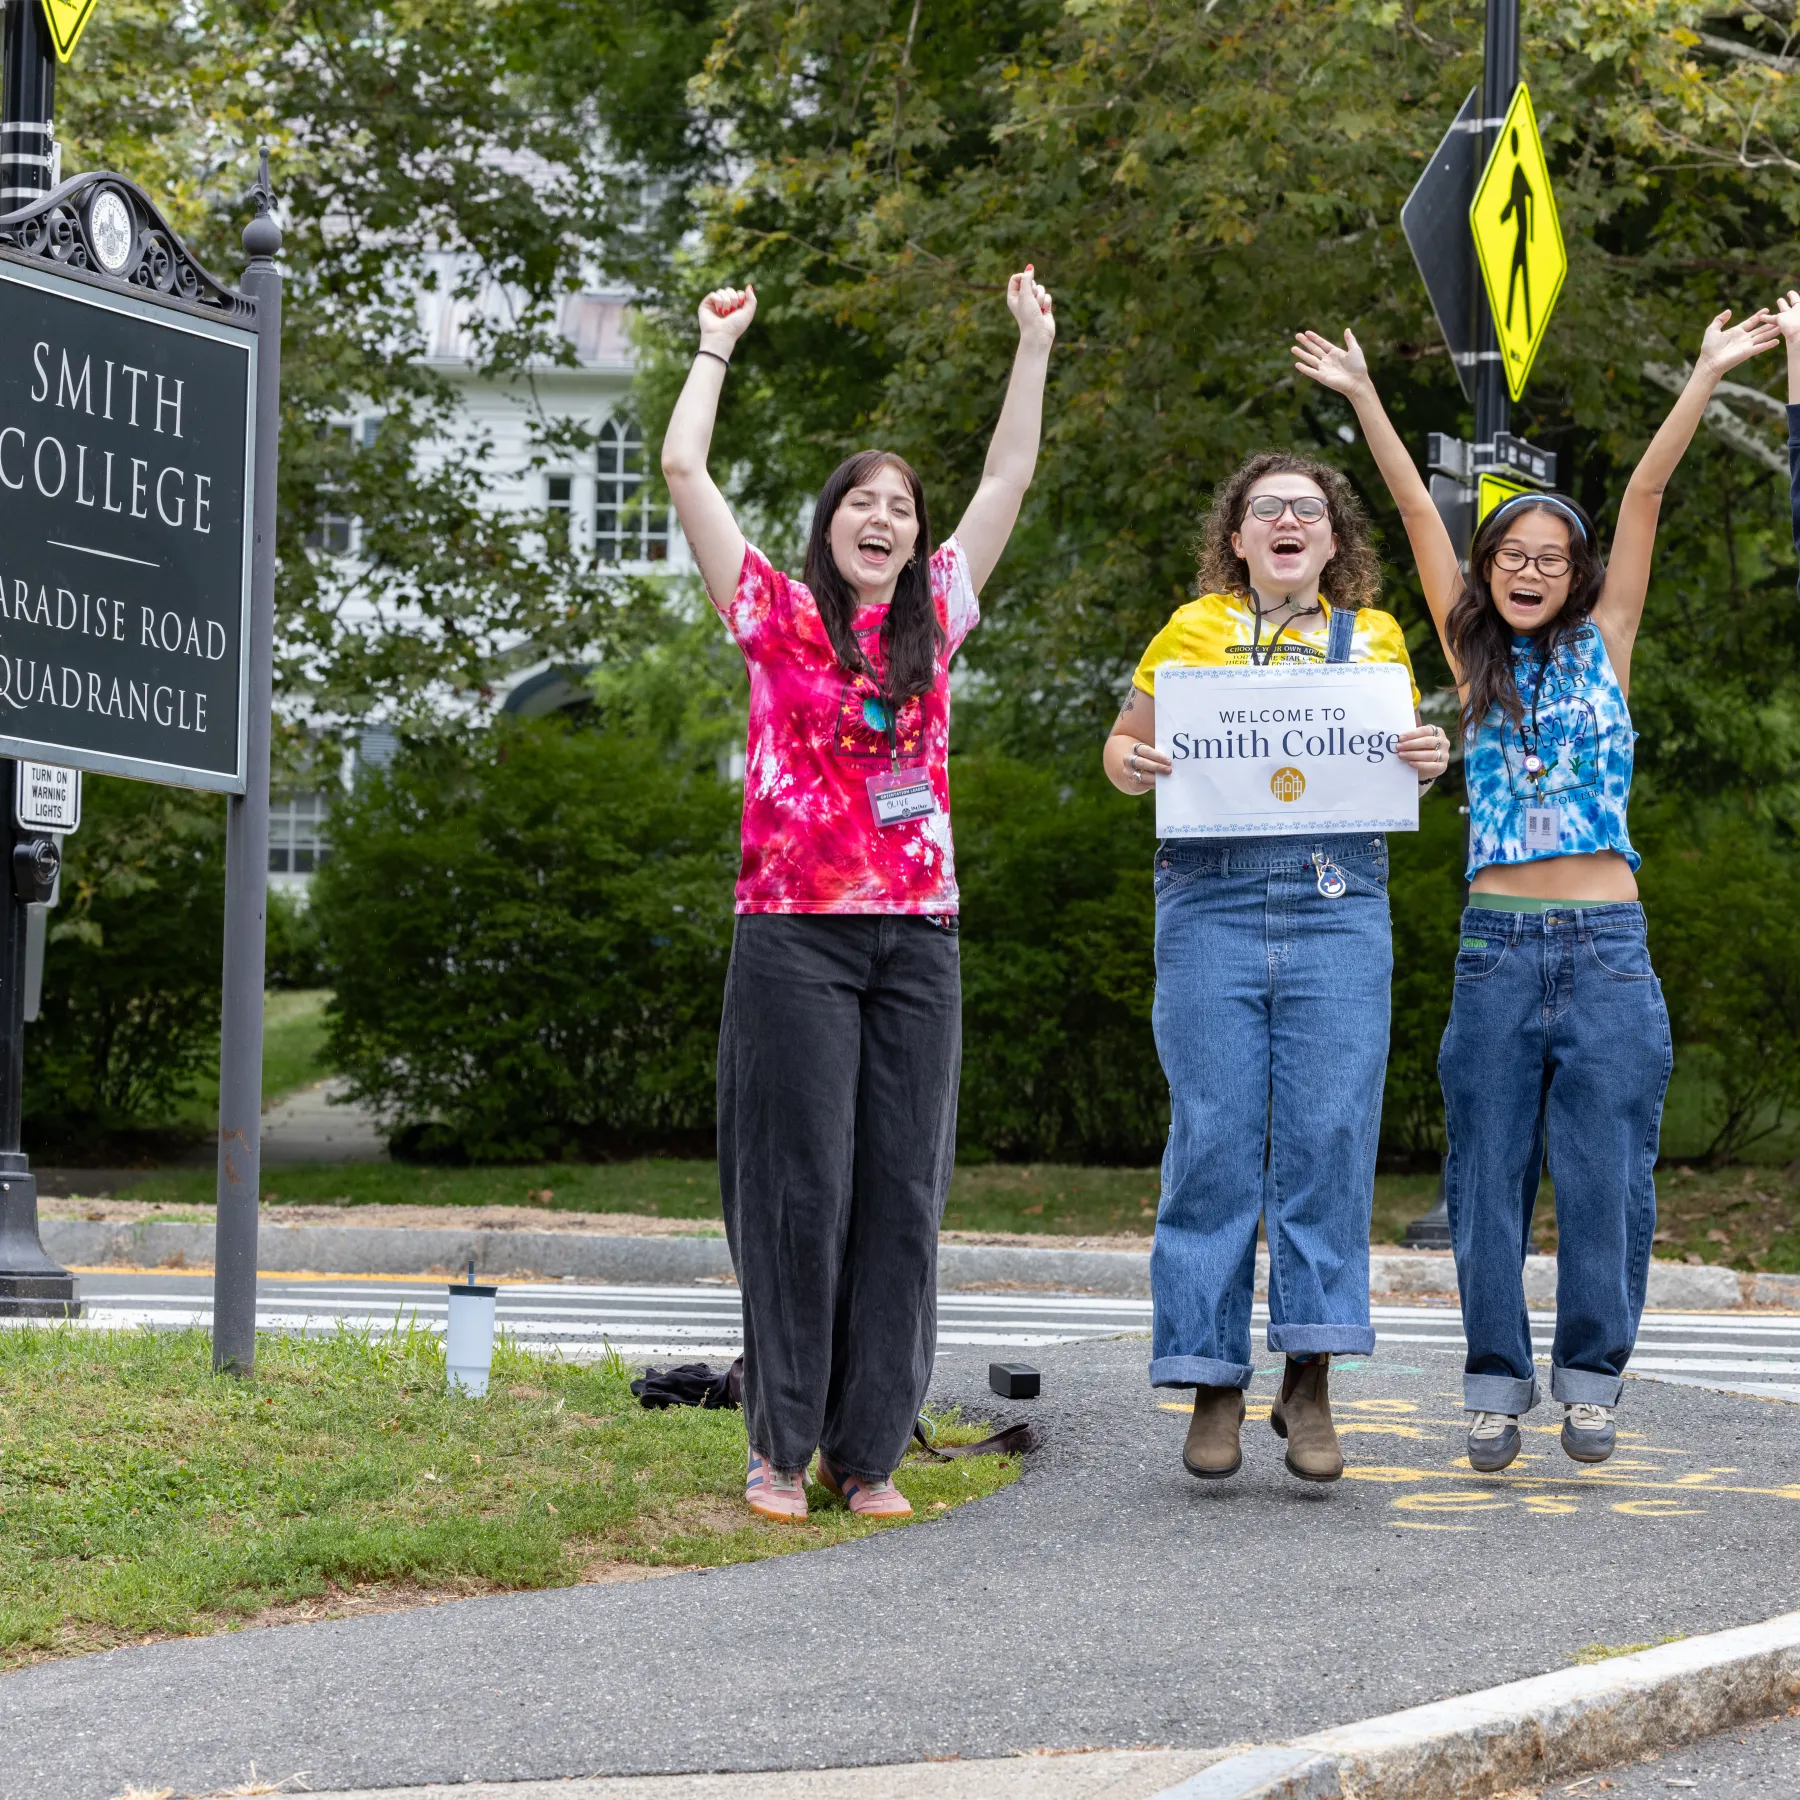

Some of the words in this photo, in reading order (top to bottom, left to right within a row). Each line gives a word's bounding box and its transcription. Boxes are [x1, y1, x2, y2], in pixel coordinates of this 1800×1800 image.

[31, 341, 185, 438] SMITH
[0, 427, 212, 534] COLLEGE
[140, 606, 226, 661] ROAD
[1283, 645, 1302, 653] OWN
[0, 654, 207, 733] QUADRANGLE
[1219, 709, 1314, 724] WELCOME
[1322, 707, 1346, 721] TO
[1172, 728, 1270, 760] Smith
[1281, 727, 1400, 763] College
[32, 768, 52, 782] TURN
[56, 771, 68, 784] ON
[32, 785, 66, 801] WARNING
[880, 790, 910, 800] ORIENTATION
[1551, 788, 1600, 807] COLLEGE
[35, 803, 62, 818] LIGHTS
